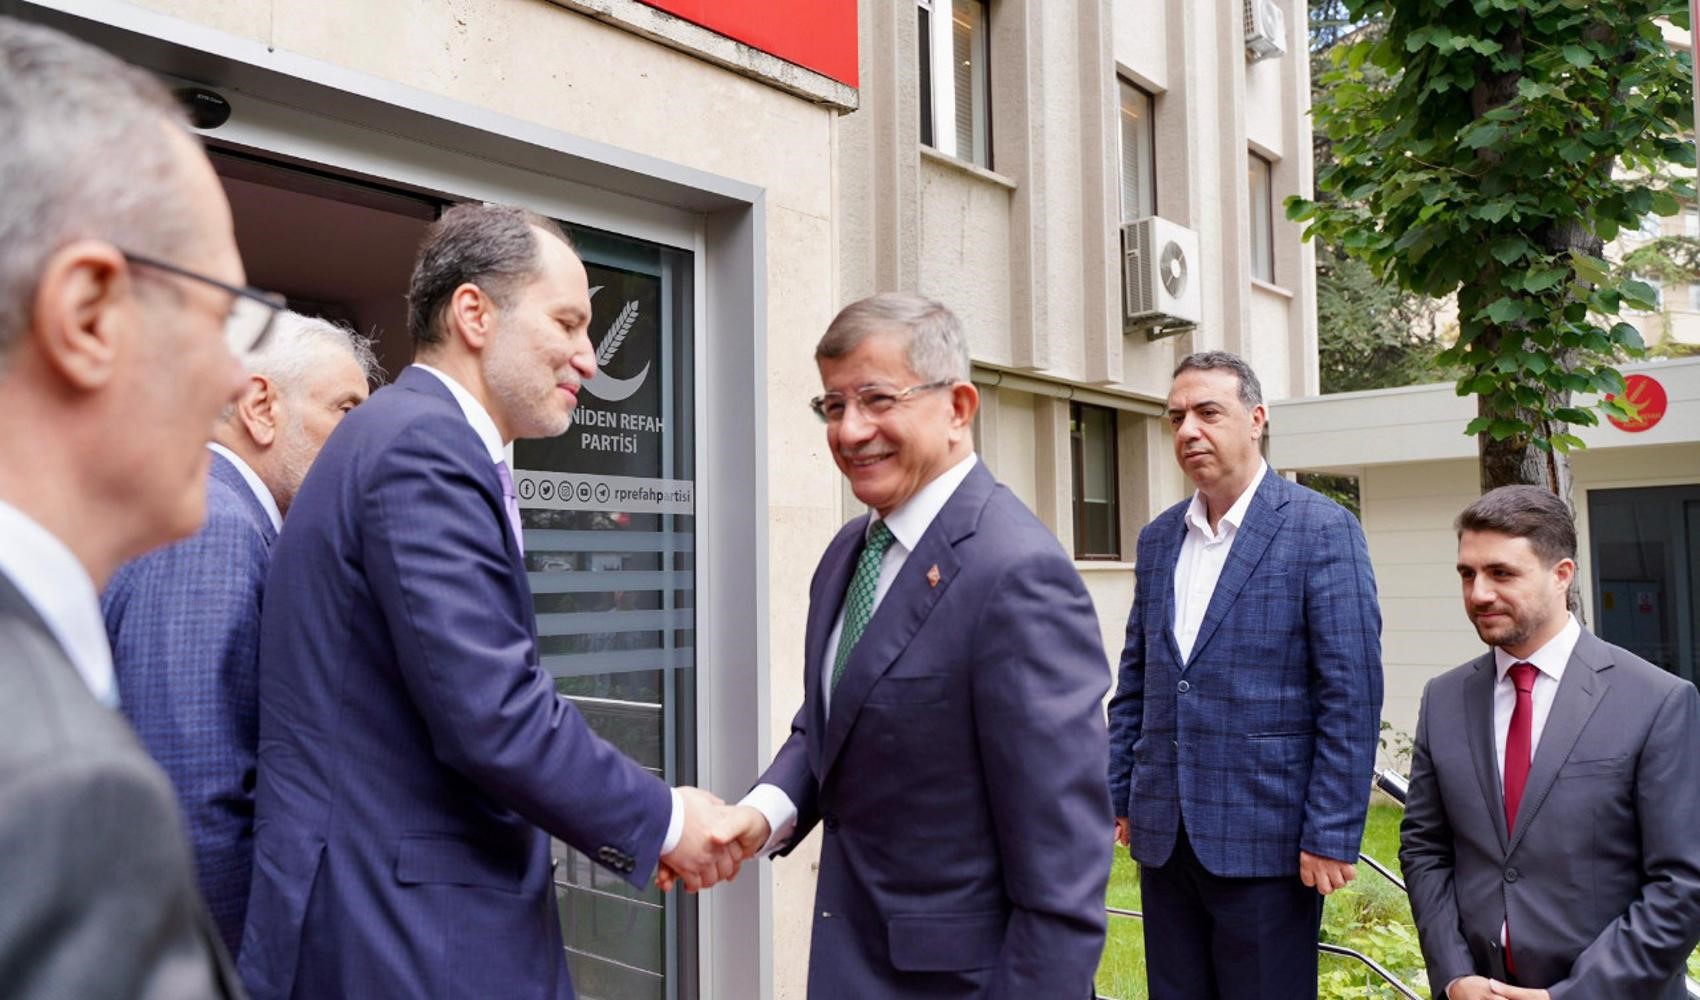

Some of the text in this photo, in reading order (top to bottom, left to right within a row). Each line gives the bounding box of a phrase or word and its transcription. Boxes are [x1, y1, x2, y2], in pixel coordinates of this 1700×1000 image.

[570, 405, 665, 432] NİDEN REFAH
[581, 433, 637, 453] PARTİSİ
[615, 487, 690, 504] rprefahpartisi
